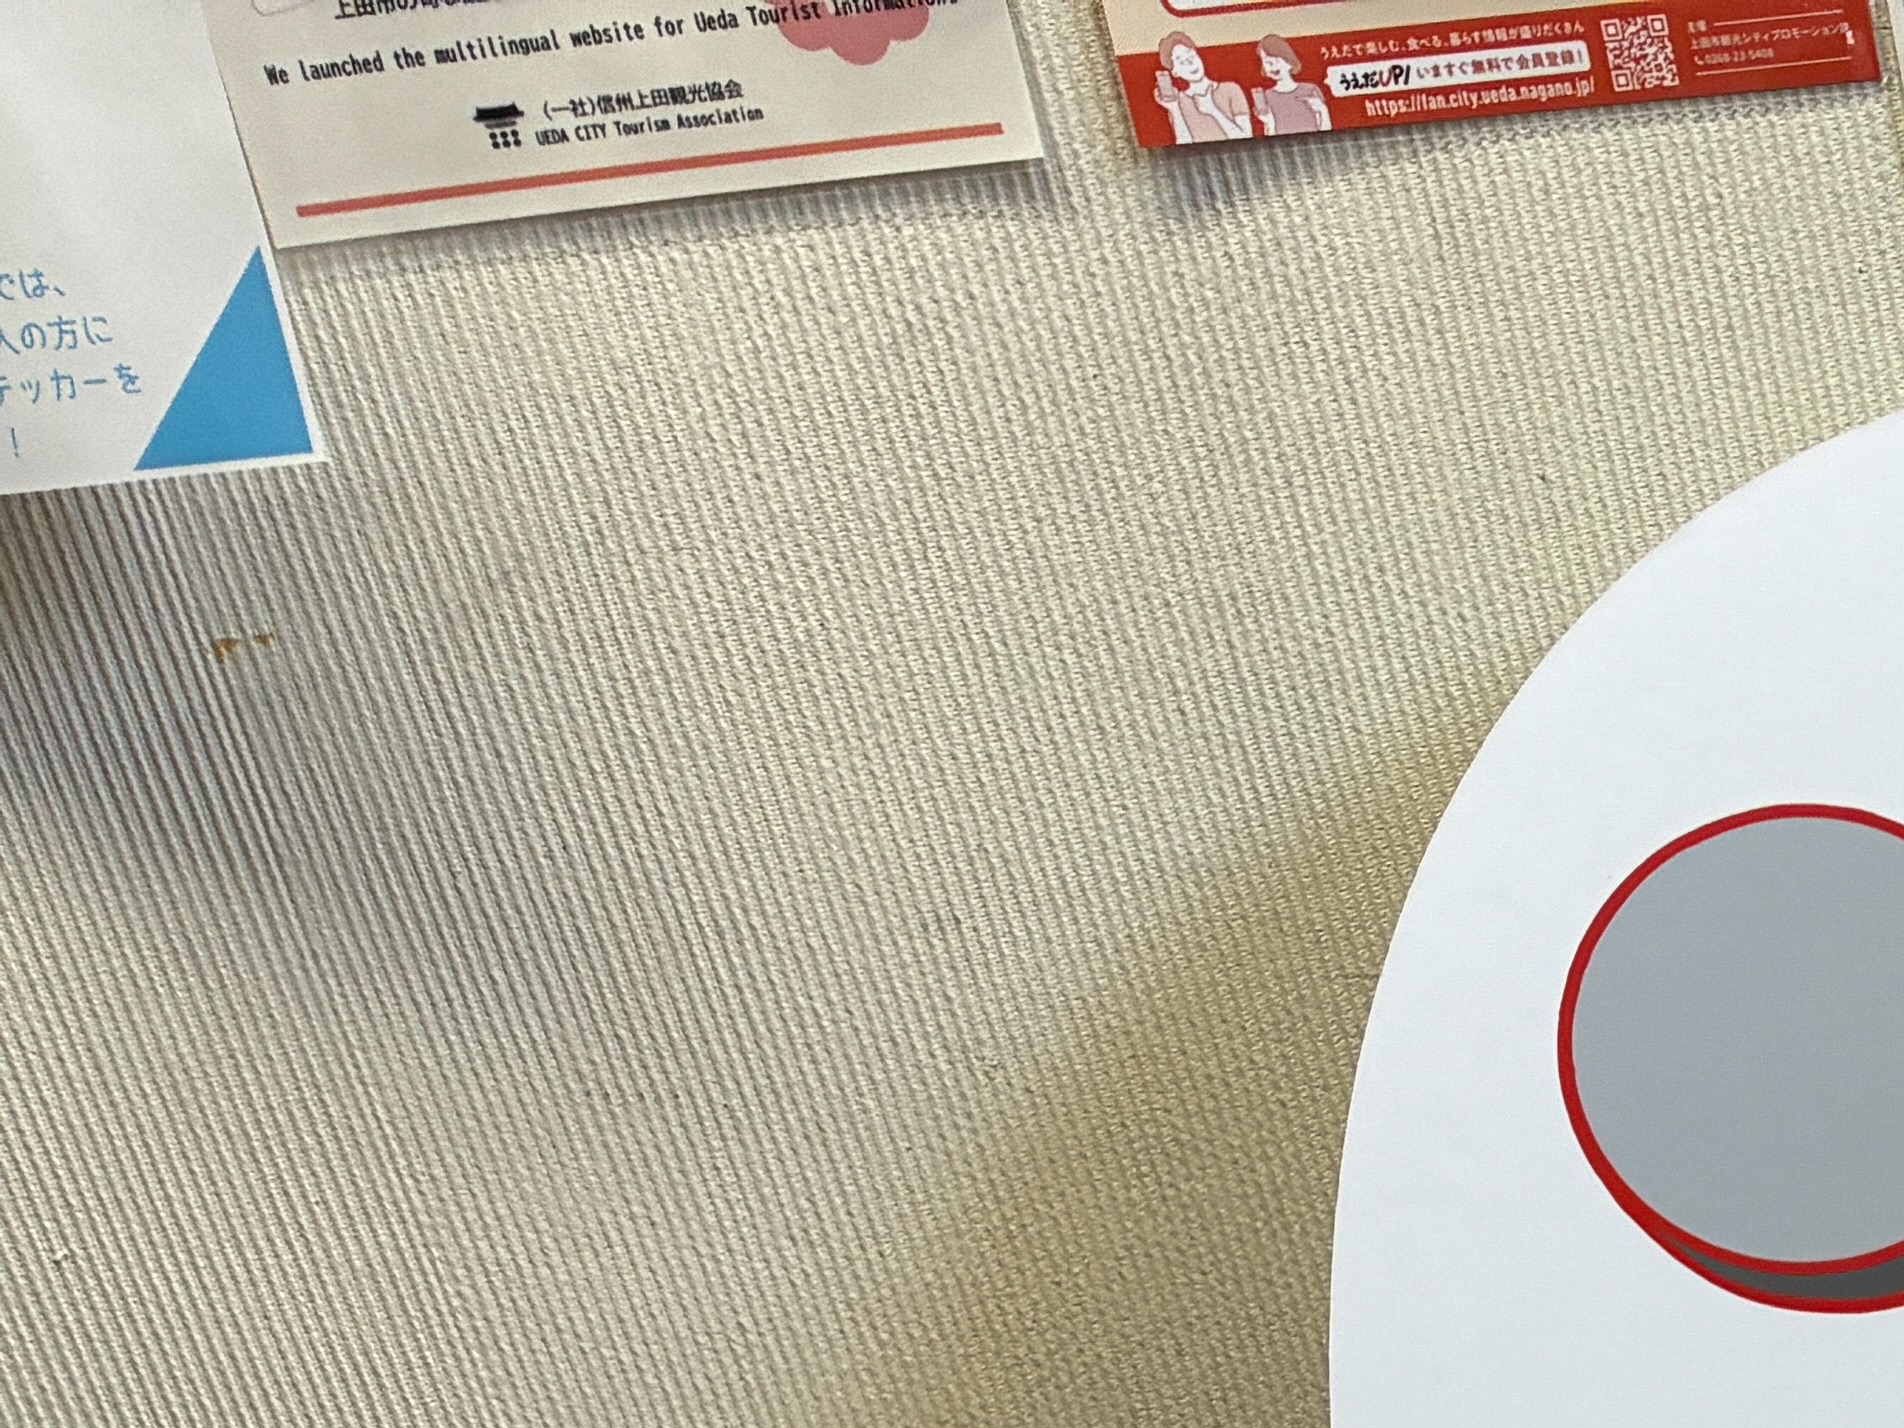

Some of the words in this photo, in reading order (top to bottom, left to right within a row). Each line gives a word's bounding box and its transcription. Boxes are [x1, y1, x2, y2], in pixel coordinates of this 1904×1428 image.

[264, 64, 290, 85] We
[299, 50, 384, 82] launched
[394, 48, 426, 71] the
[434, 29, 560, 64] multilingual
[570, 20, 645, 48] website
[654, 15, 685, 37] for
[695, 9, 740, 33] Ueda
[746, 0, 823, 27] Tourist
[536, 129, 569, 147] UEDA
[574, 125, 606, 141] CITY
[616, 117, 671, 137] Tourism
[677, 106, 764, 130] Association
